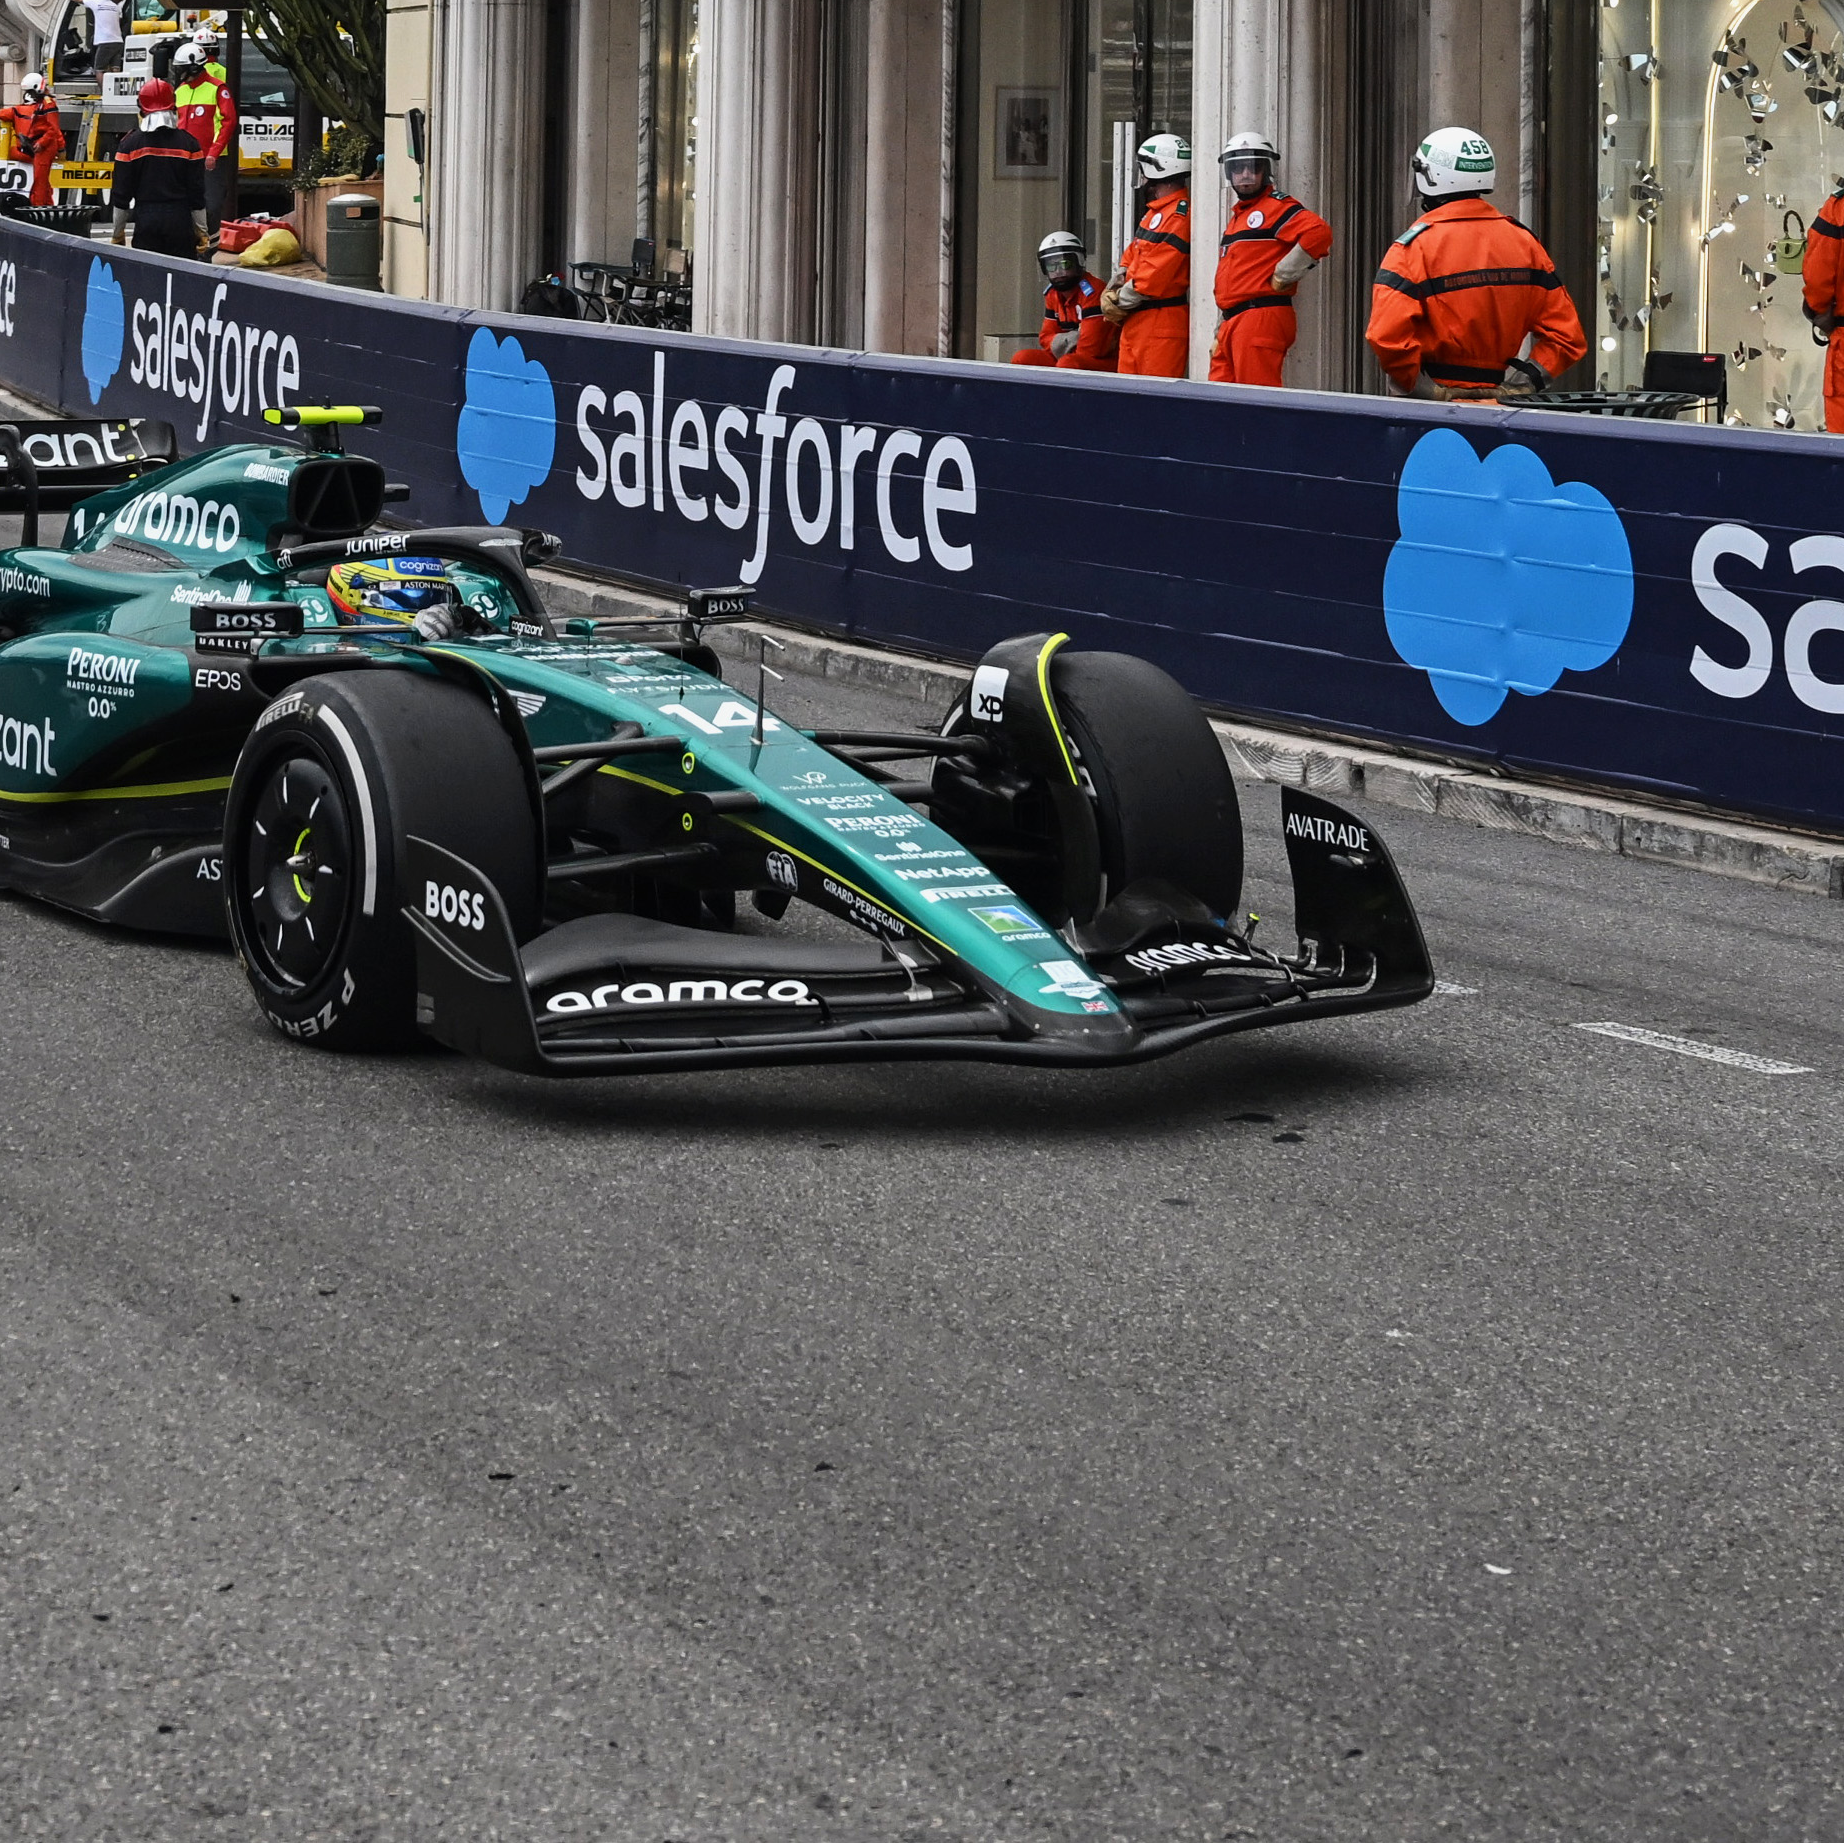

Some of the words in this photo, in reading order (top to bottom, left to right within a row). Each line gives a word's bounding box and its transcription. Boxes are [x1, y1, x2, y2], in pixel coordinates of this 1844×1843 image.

[1461, 140, 1489, 155] 458
[130, 271, 300, 443] salesforce
[243, 462, 290, 487] BOMBARDIER
[575, 350, 977, 585] salesforce
[113, 491, 240, 553] aramco
[404, 581, 431, 589] ASTON
[707, 597, 745, 615] BOSS
[215, 612, 277, 630] BOSS
[511, 620, 544, 637] cognizant
[66, 646, 142, 686] PERONI
[66, 679, 96, 693] NASTRO
[97, 683, 135, 698] AZZURRO
[194, 667, 242, 692] EPOS
[88, 696, 117, 719] 0.0%
[658, 701, 782, 735] 14
[796, 793, 886, 807] VELOCITY
[826, 801, 876, 811] BLACK
[823, 814, 918, 830] PERONI
[1285, 811, 1371, 853] AVATRADE
[873, 848, 967, 862] SentinelOne
[768, 858, 798, 891] FIA
[894, 865, 991, 881] NetApp
[424, 880, 486, 931] BOSS
[919, 884, 1017, 904] PIRELL
[822, 877, 907, 937] GIRARD-PERREGAUX
[1001, 931, 1051, 942] aramco
[1125, 940, 1252, 973] aramco
[546, 979, 809, 1013] aramco
